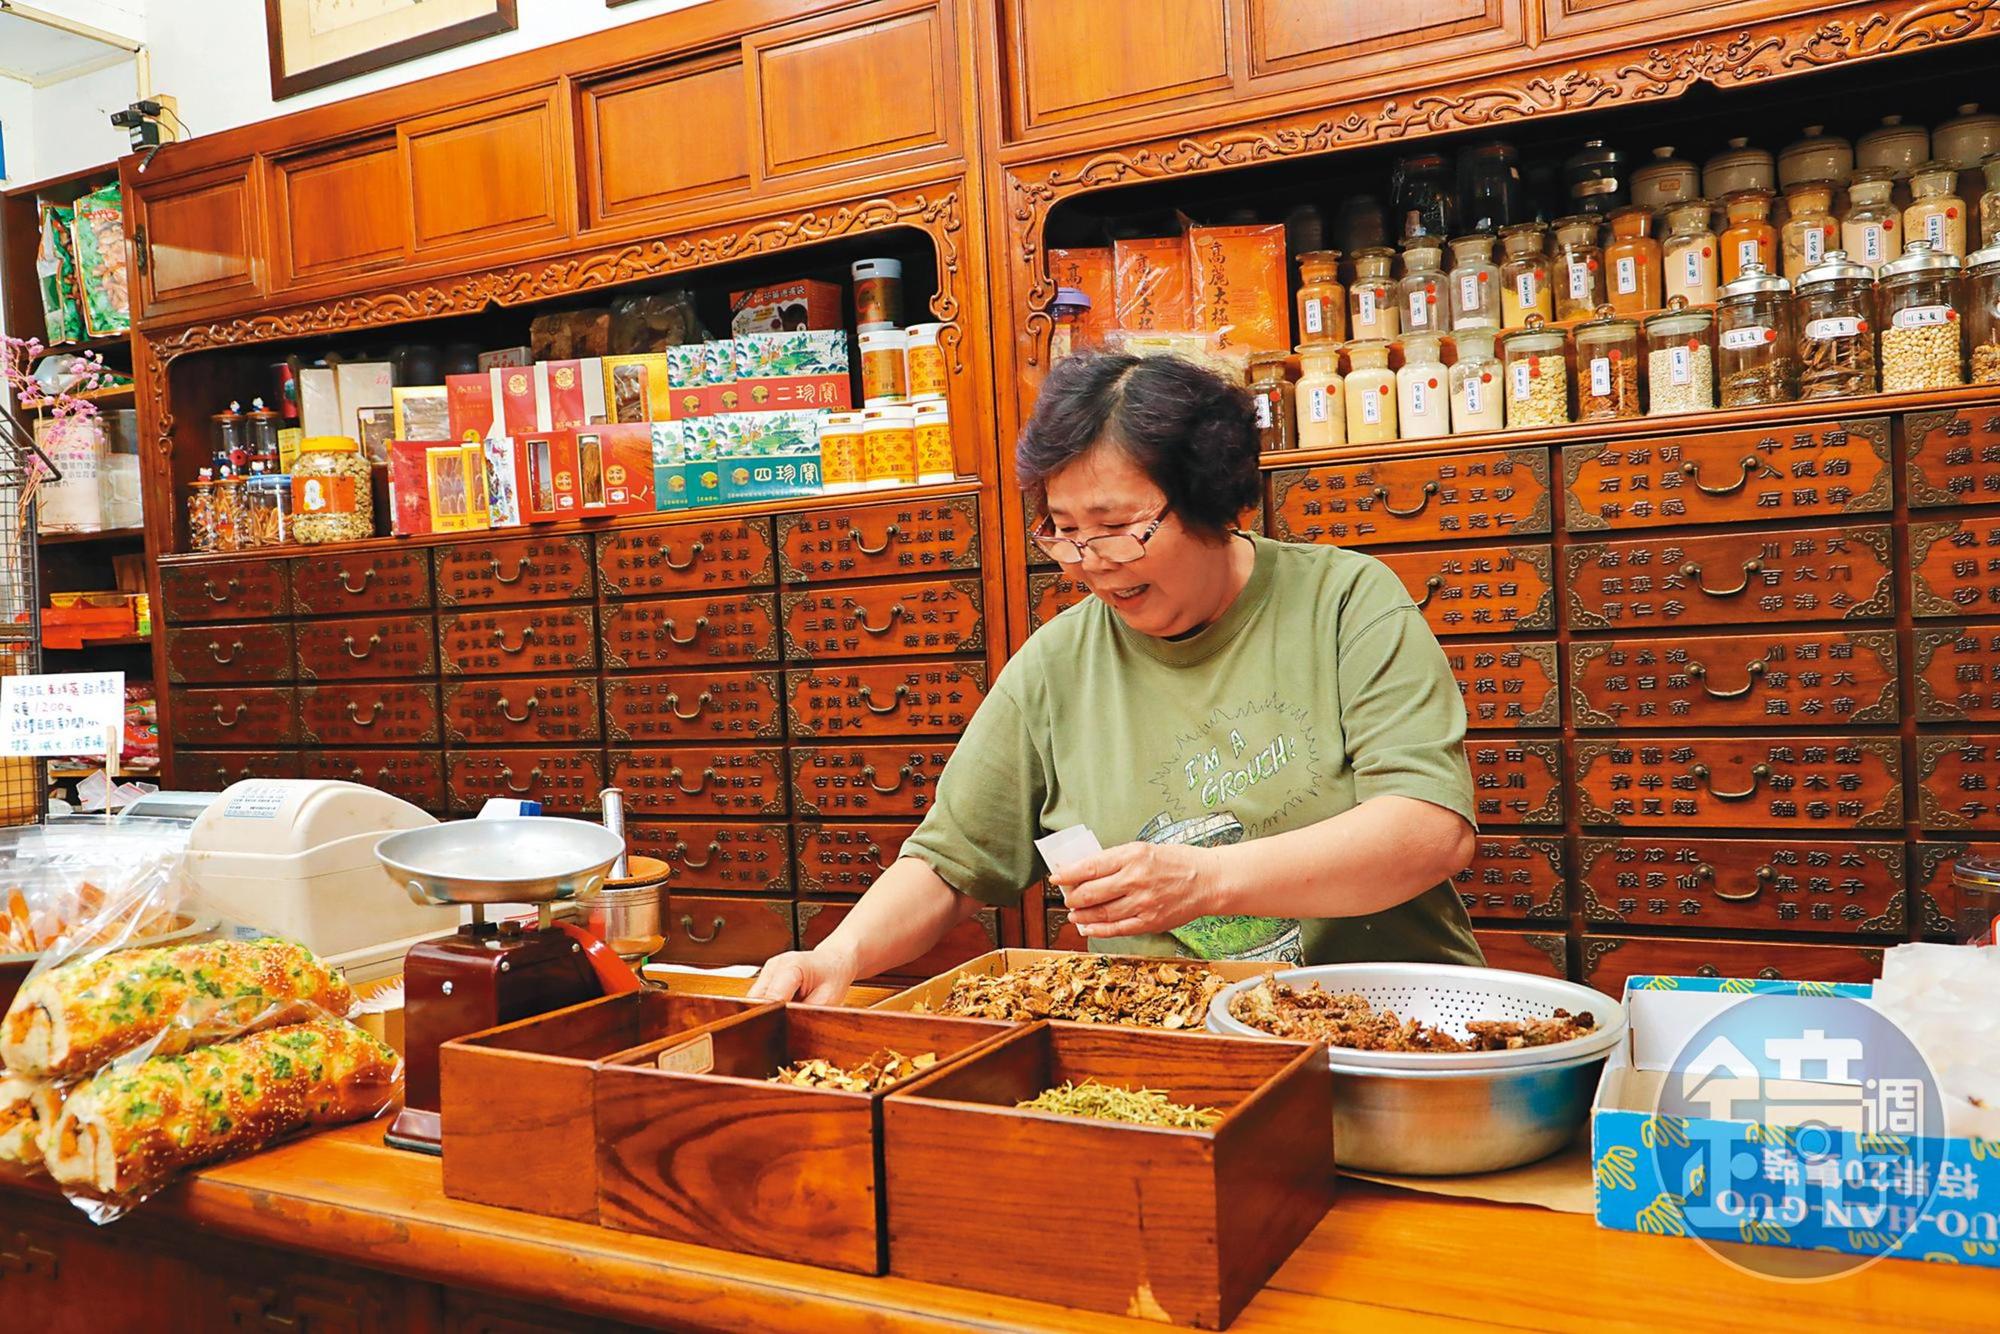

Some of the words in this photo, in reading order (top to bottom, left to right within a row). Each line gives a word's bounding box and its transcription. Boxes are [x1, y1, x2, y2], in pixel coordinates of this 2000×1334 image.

[1354, 472, 1376, 534] 益智仁
[1598, 450, 1623, 518] 金石斛
[1758, 541, 1784, 613] 川百部
[1634, 649, 1658, 717] 桑白皮
[1183, 745, 1221, 790] I'M
[1229, 728, 1246, 759] A
[1200, 733, 1298, 808] GROUCH!
[1503, 749, 1529, 813] 田川七
[1716, 1190, 2000, 1241] UO-HAN-GUO
